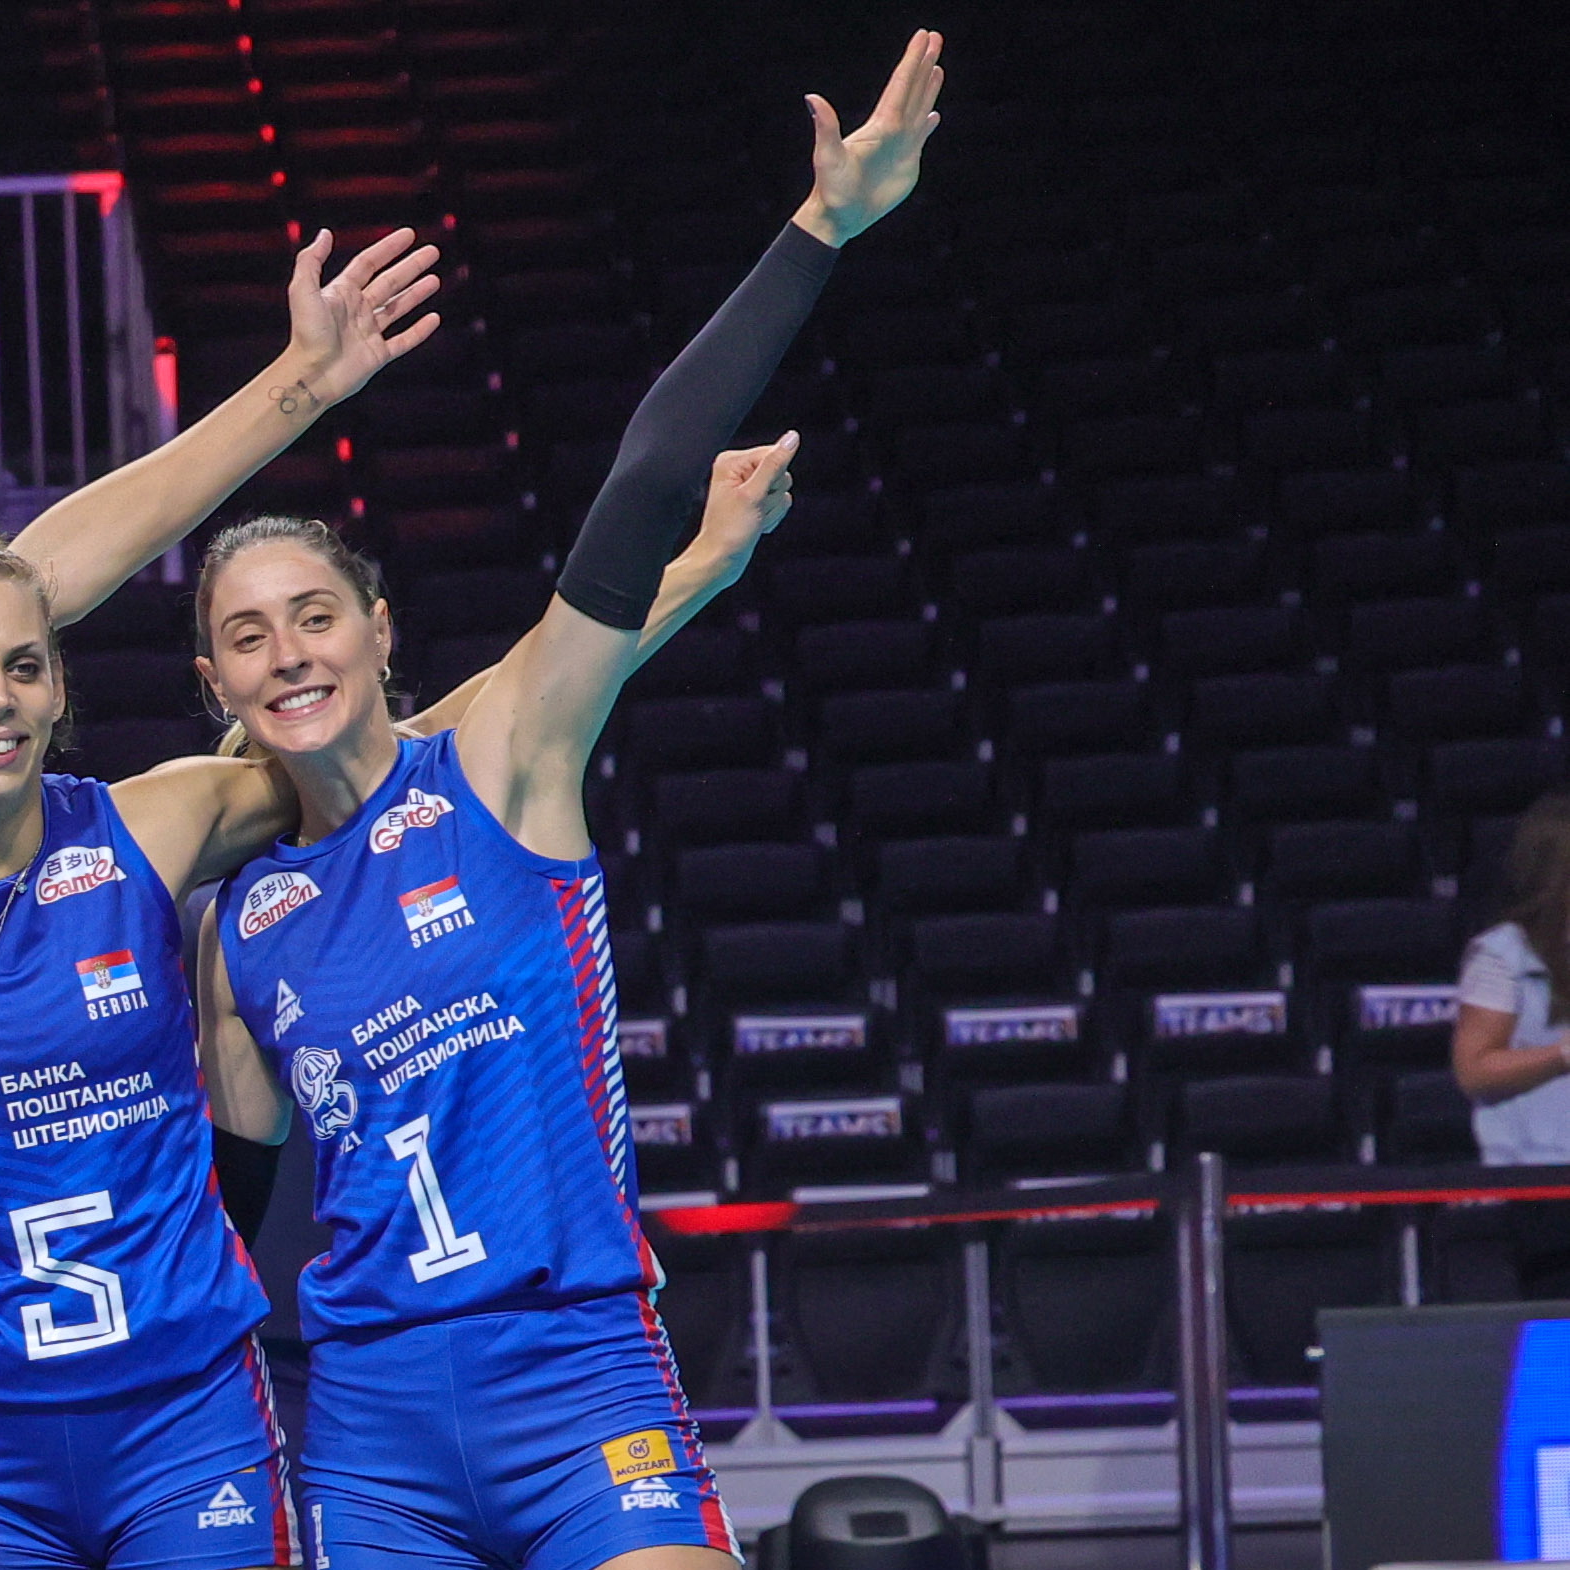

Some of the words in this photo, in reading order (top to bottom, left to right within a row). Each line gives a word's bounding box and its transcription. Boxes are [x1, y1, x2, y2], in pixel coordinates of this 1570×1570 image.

[46, 849, 101, 876] 百岁山
[242, 881, 316, 936] Ganten
[247, 873, 295, 910] 百岁山
[409, 909, 477, 950] SERBIA
[86, 992, 150, 1022] SERBIA
[272, 994, 306, 1043] PEAK
[350, 994, 424, 1047] БАНКА
[362, 991, 500, 1072] ПОШТАНСКА
[0, 1060, 87, 1097] БАНКА
[378, 1013, 527, 1097] ШТЕДИОНИЦА
[5, 1070, 155, 1123] ПОШТАНСКА
[11, 1094, 171, 1152] ШТЕДИОНИЦА
[384, 1113, 488, 1284] 1
[8, 1189, 131, 1361] 5
[615, 1456, 673, 1479] MOZZART
[197, 1504, 257, 1530] PEAK
[620, 1490, 682, 1513] PEAK
[310, 1504, 331, 1570] 1
